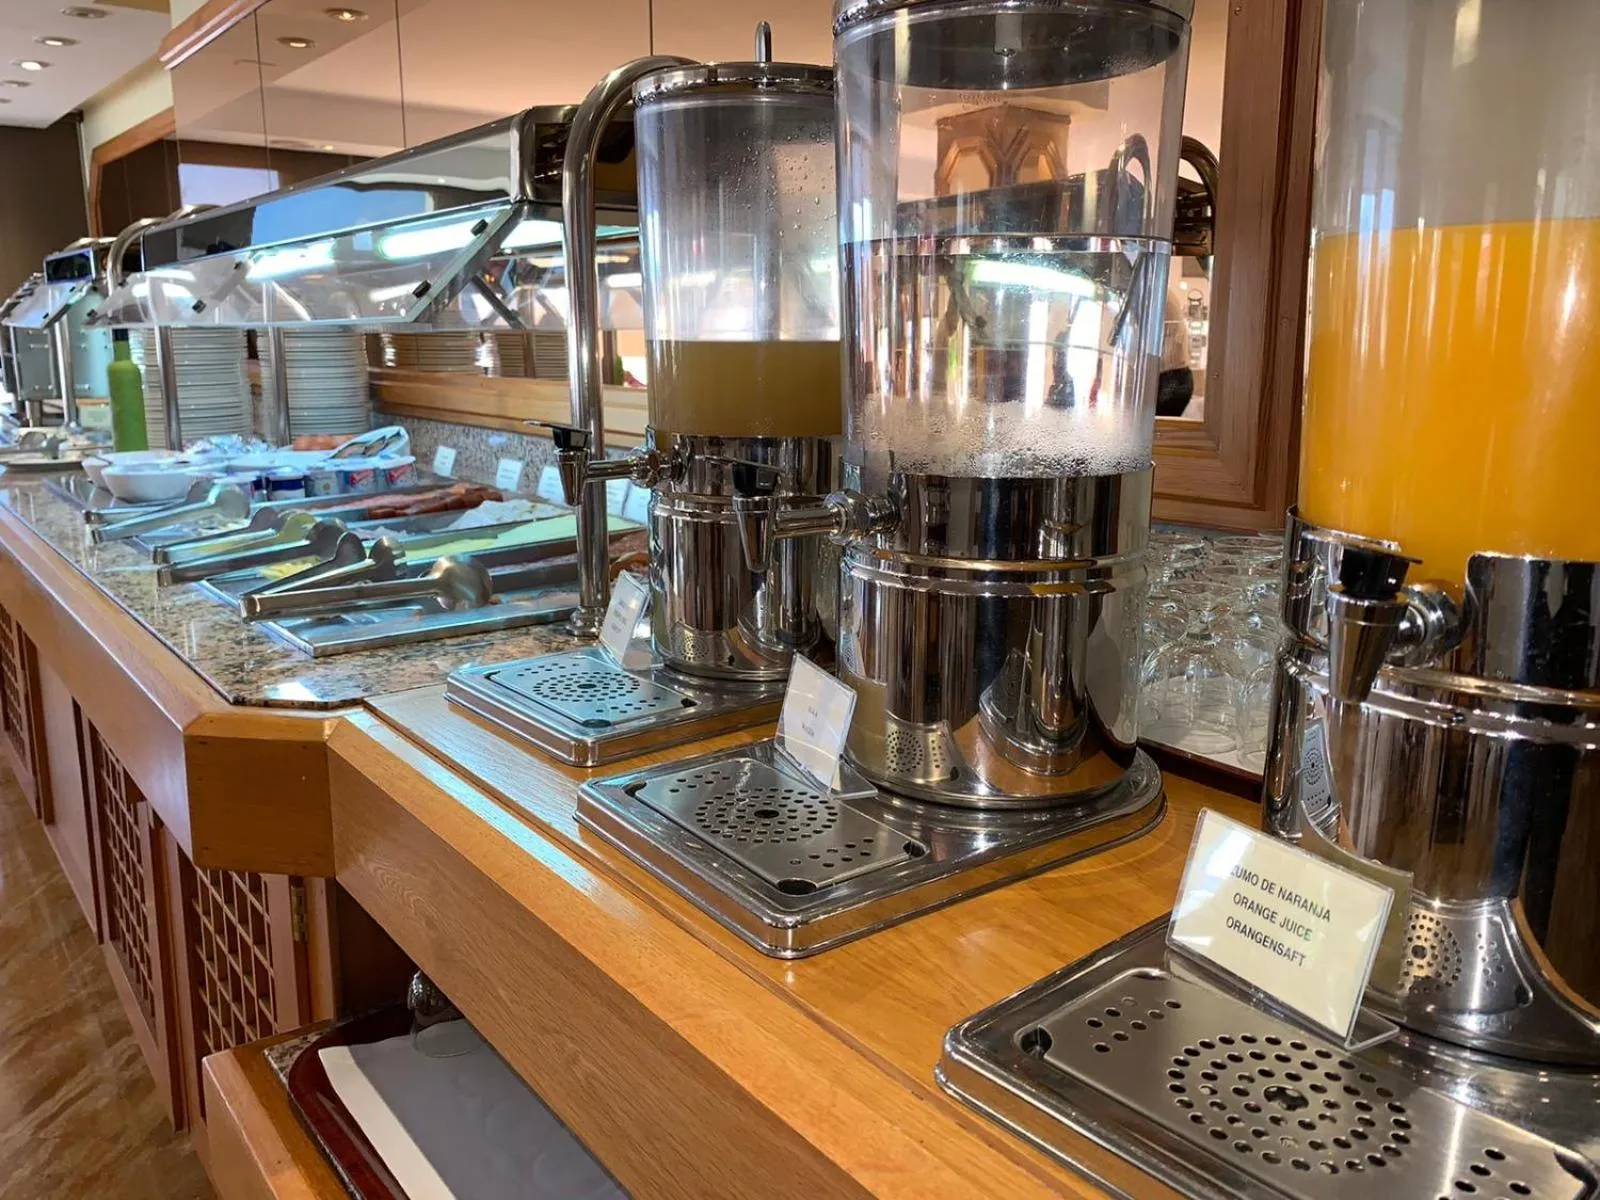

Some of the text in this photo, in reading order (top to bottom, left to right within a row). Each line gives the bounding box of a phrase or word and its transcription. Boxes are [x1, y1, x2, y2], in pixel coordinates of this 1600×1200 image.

[1232, 891, 1313, 942] ORANGE JUICE
[1260, 878, 1277, 896] DE
[1277, 885, 1332, 923] NARANJA
[1225, 915, 1307, 968] ORANGENSAFT
